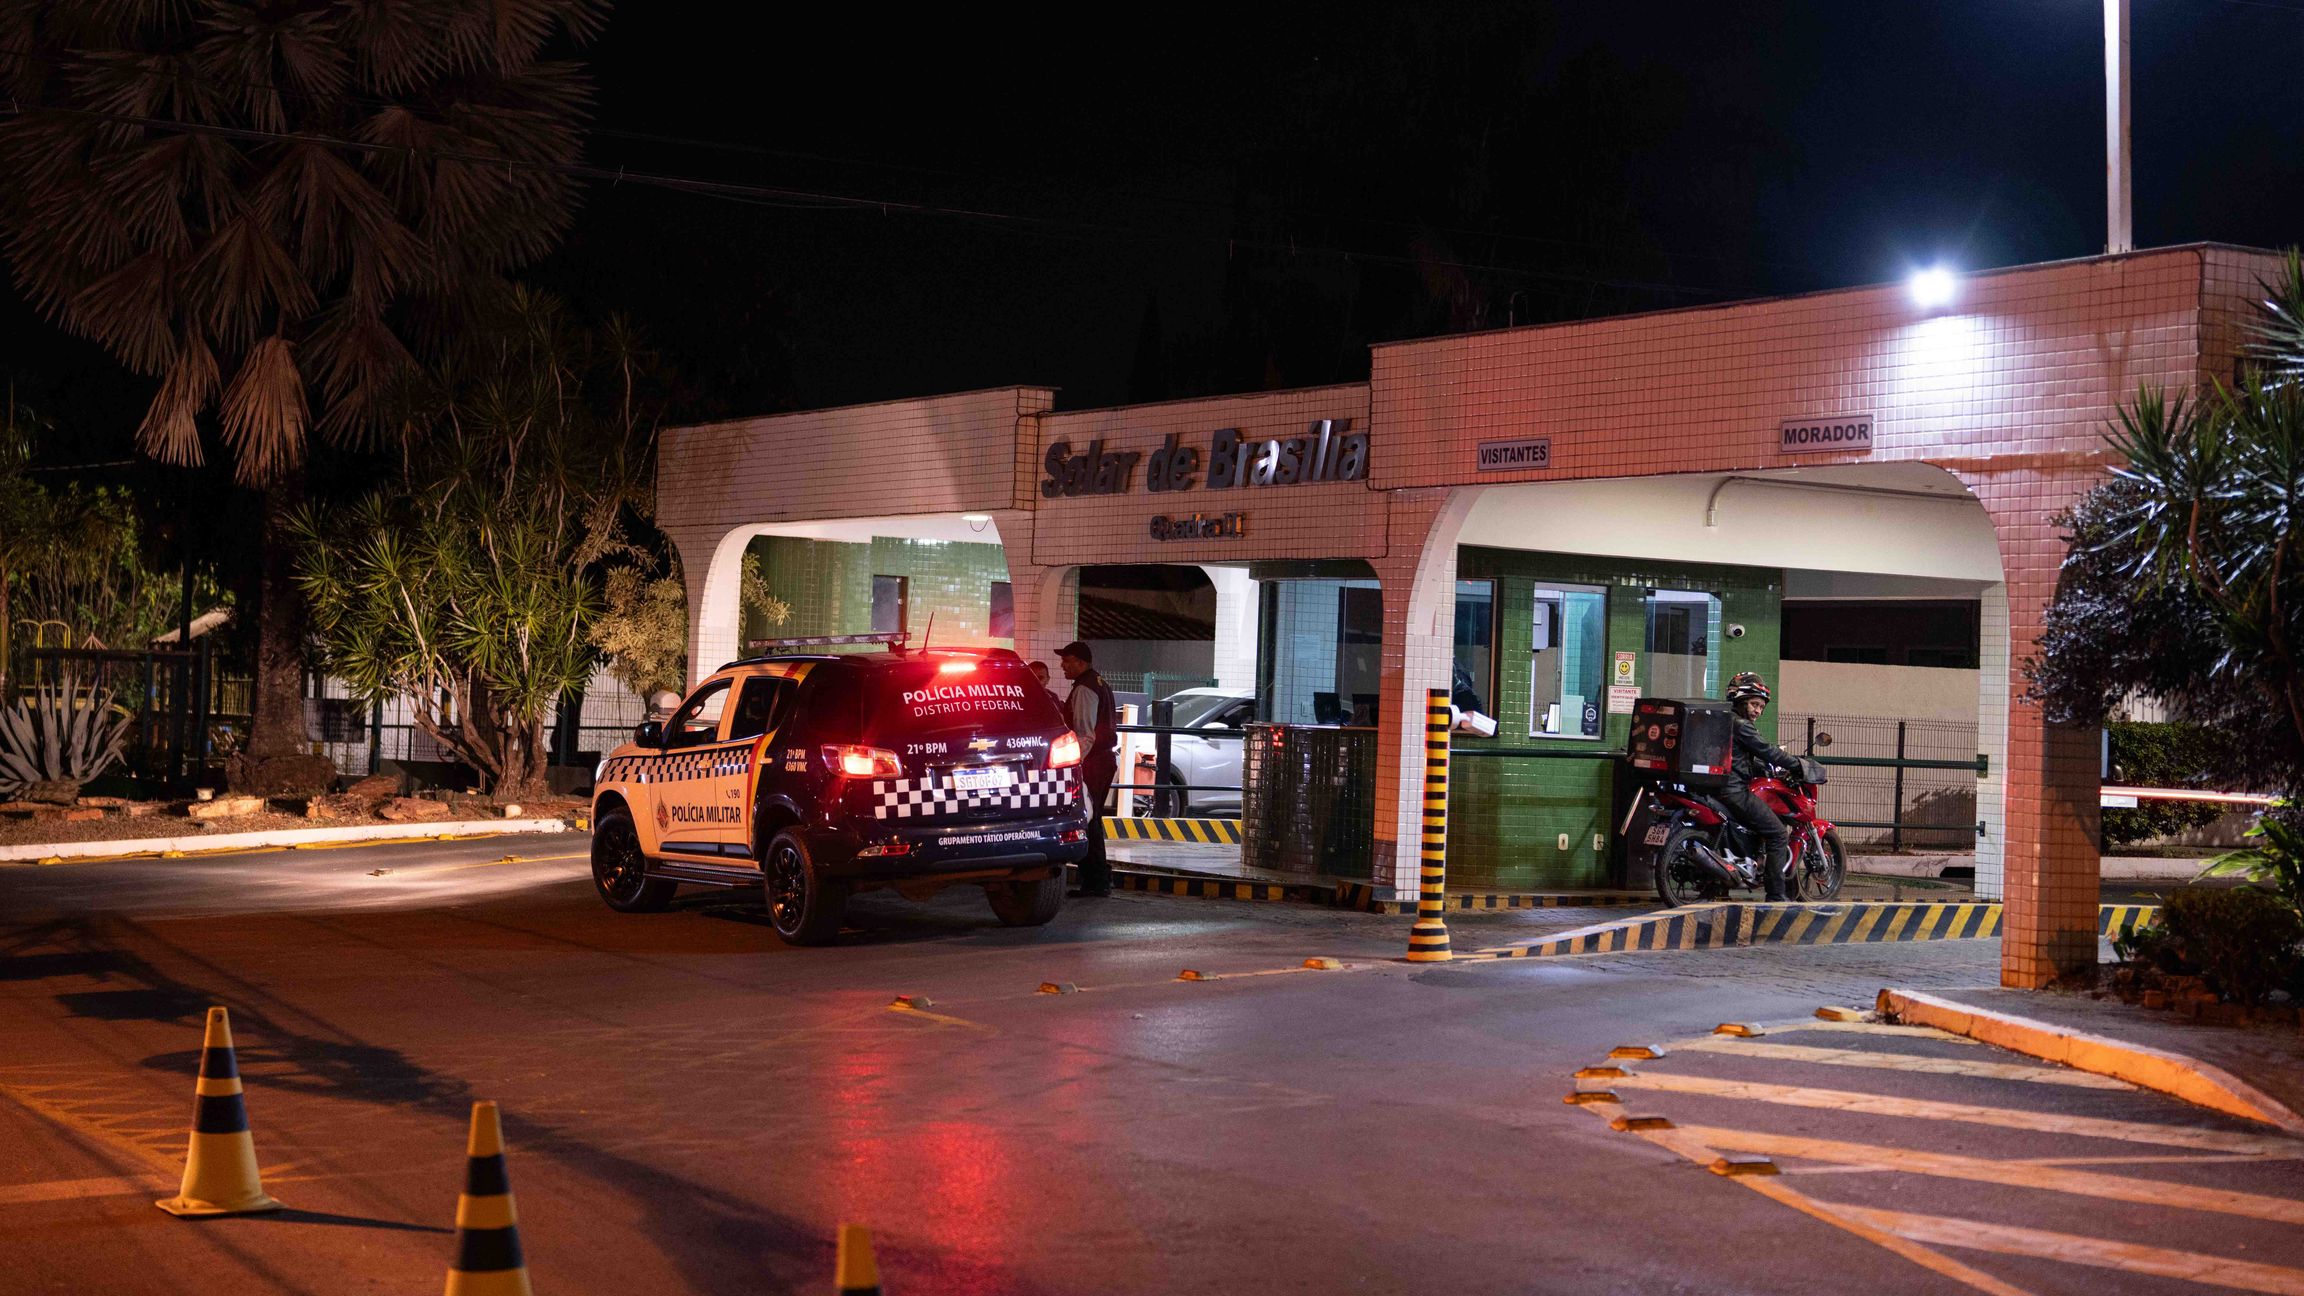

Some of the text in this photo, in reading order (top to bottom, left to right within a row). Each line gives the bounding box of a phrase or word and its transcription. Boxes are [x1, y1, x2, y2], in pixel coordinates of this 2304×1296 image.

[1783, 422, 1869, 445] MORADOR
[1041, 418, 1369, 499] Solar de Brasília
[1480, 444, 1547, 465] VISITANTES
[1150, 511, 1223, 541] Quadra
[903, 684, 1025, 705] POLÍCIA MILITAR
[913, 700, 1024, 717] DISTRITO FEDERAL
[925, 742, 948, 754] BPM
[1006, 737, 1025, 748] 4360
[795, 748, 806, 759] BPM
[730, 789, 740, 799] 190
[672, 802, 742, 824] POLÍCIA MILITAR
[938, 830, 1041, 846] GRUPAMENTO TÁTICO OPERACIONAL
